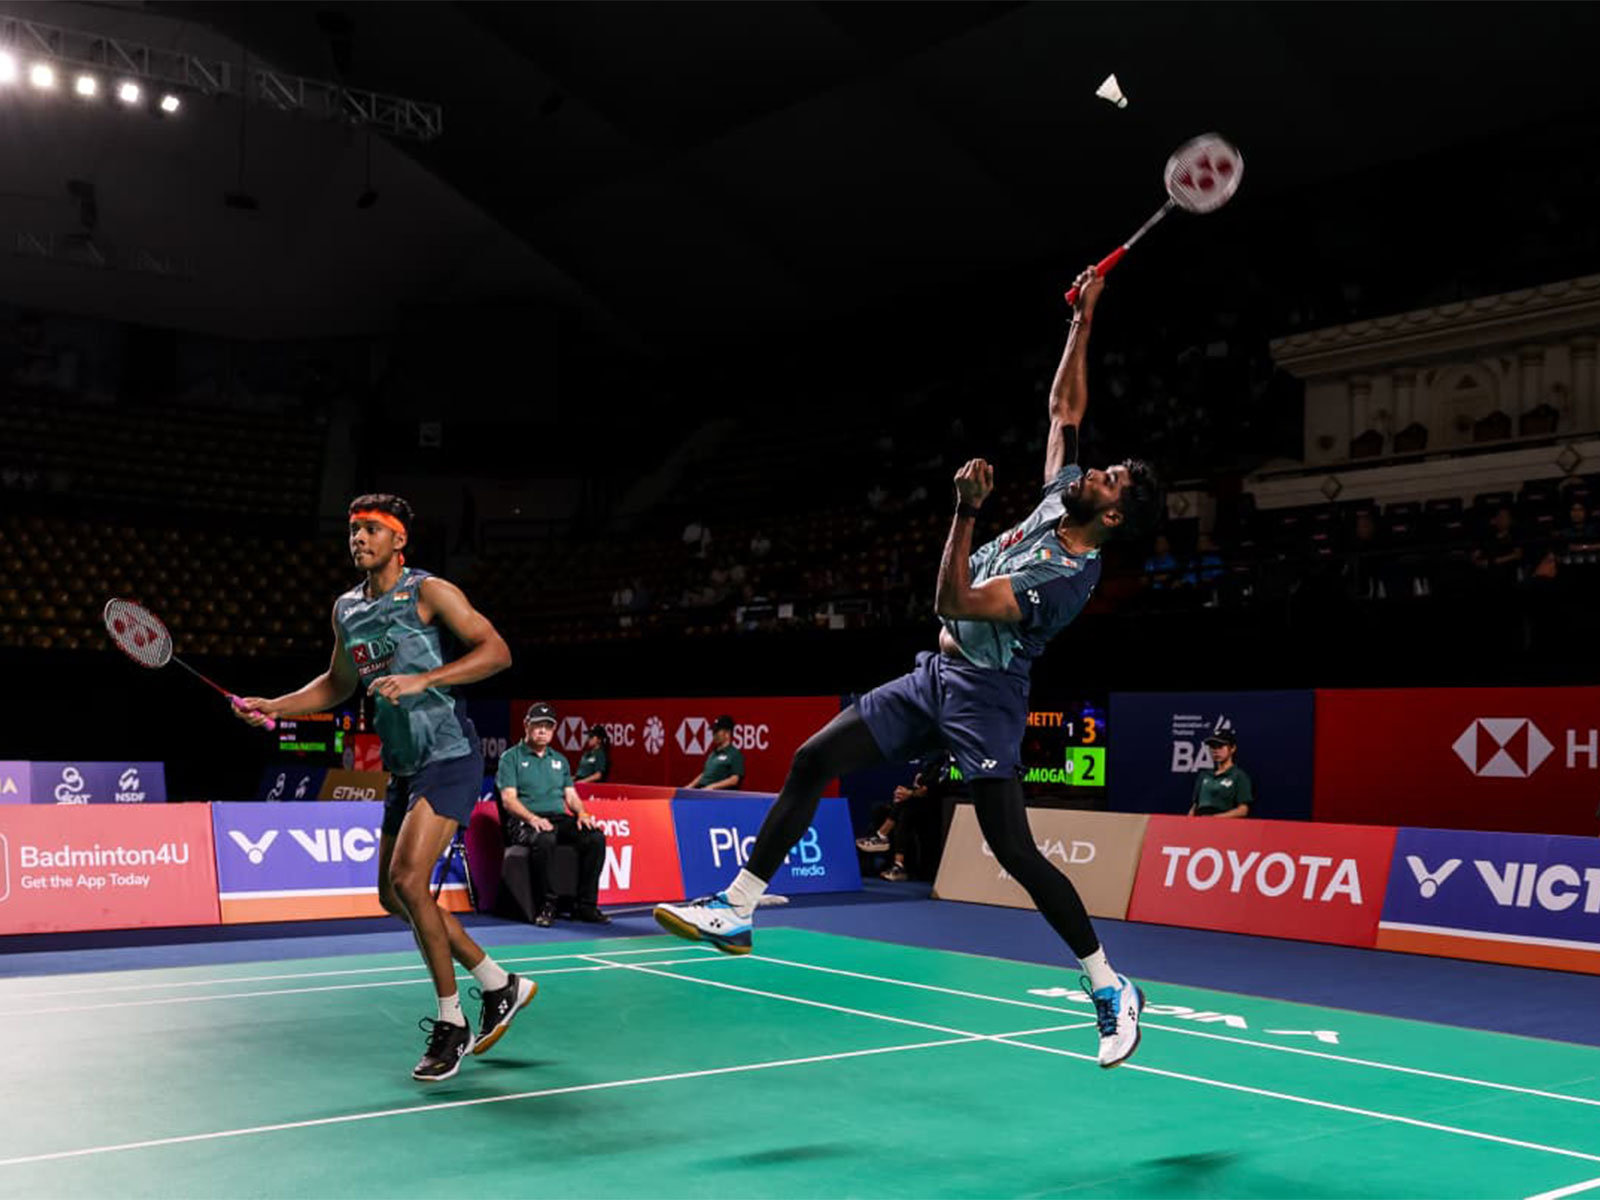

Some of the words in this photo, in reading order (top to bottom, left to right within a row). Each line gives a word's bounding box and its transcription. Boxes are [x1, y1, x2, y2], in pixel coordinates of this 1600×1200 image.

[1082, 717, 1096, 744] 3
[1082, 755, 1095, 780] 2
[20, 843, 189, 867] Badminton4U
[288, 827, 383, 862] VIC
[21, 875, 47, 889] Get
[49, 873, 73, 888] the
[76, 873, 106, 890] App
[109, 872, 151, 889] Today
[791, 865, 826, 876] media
[1162, 846, 1364, 905] TOYOTA
